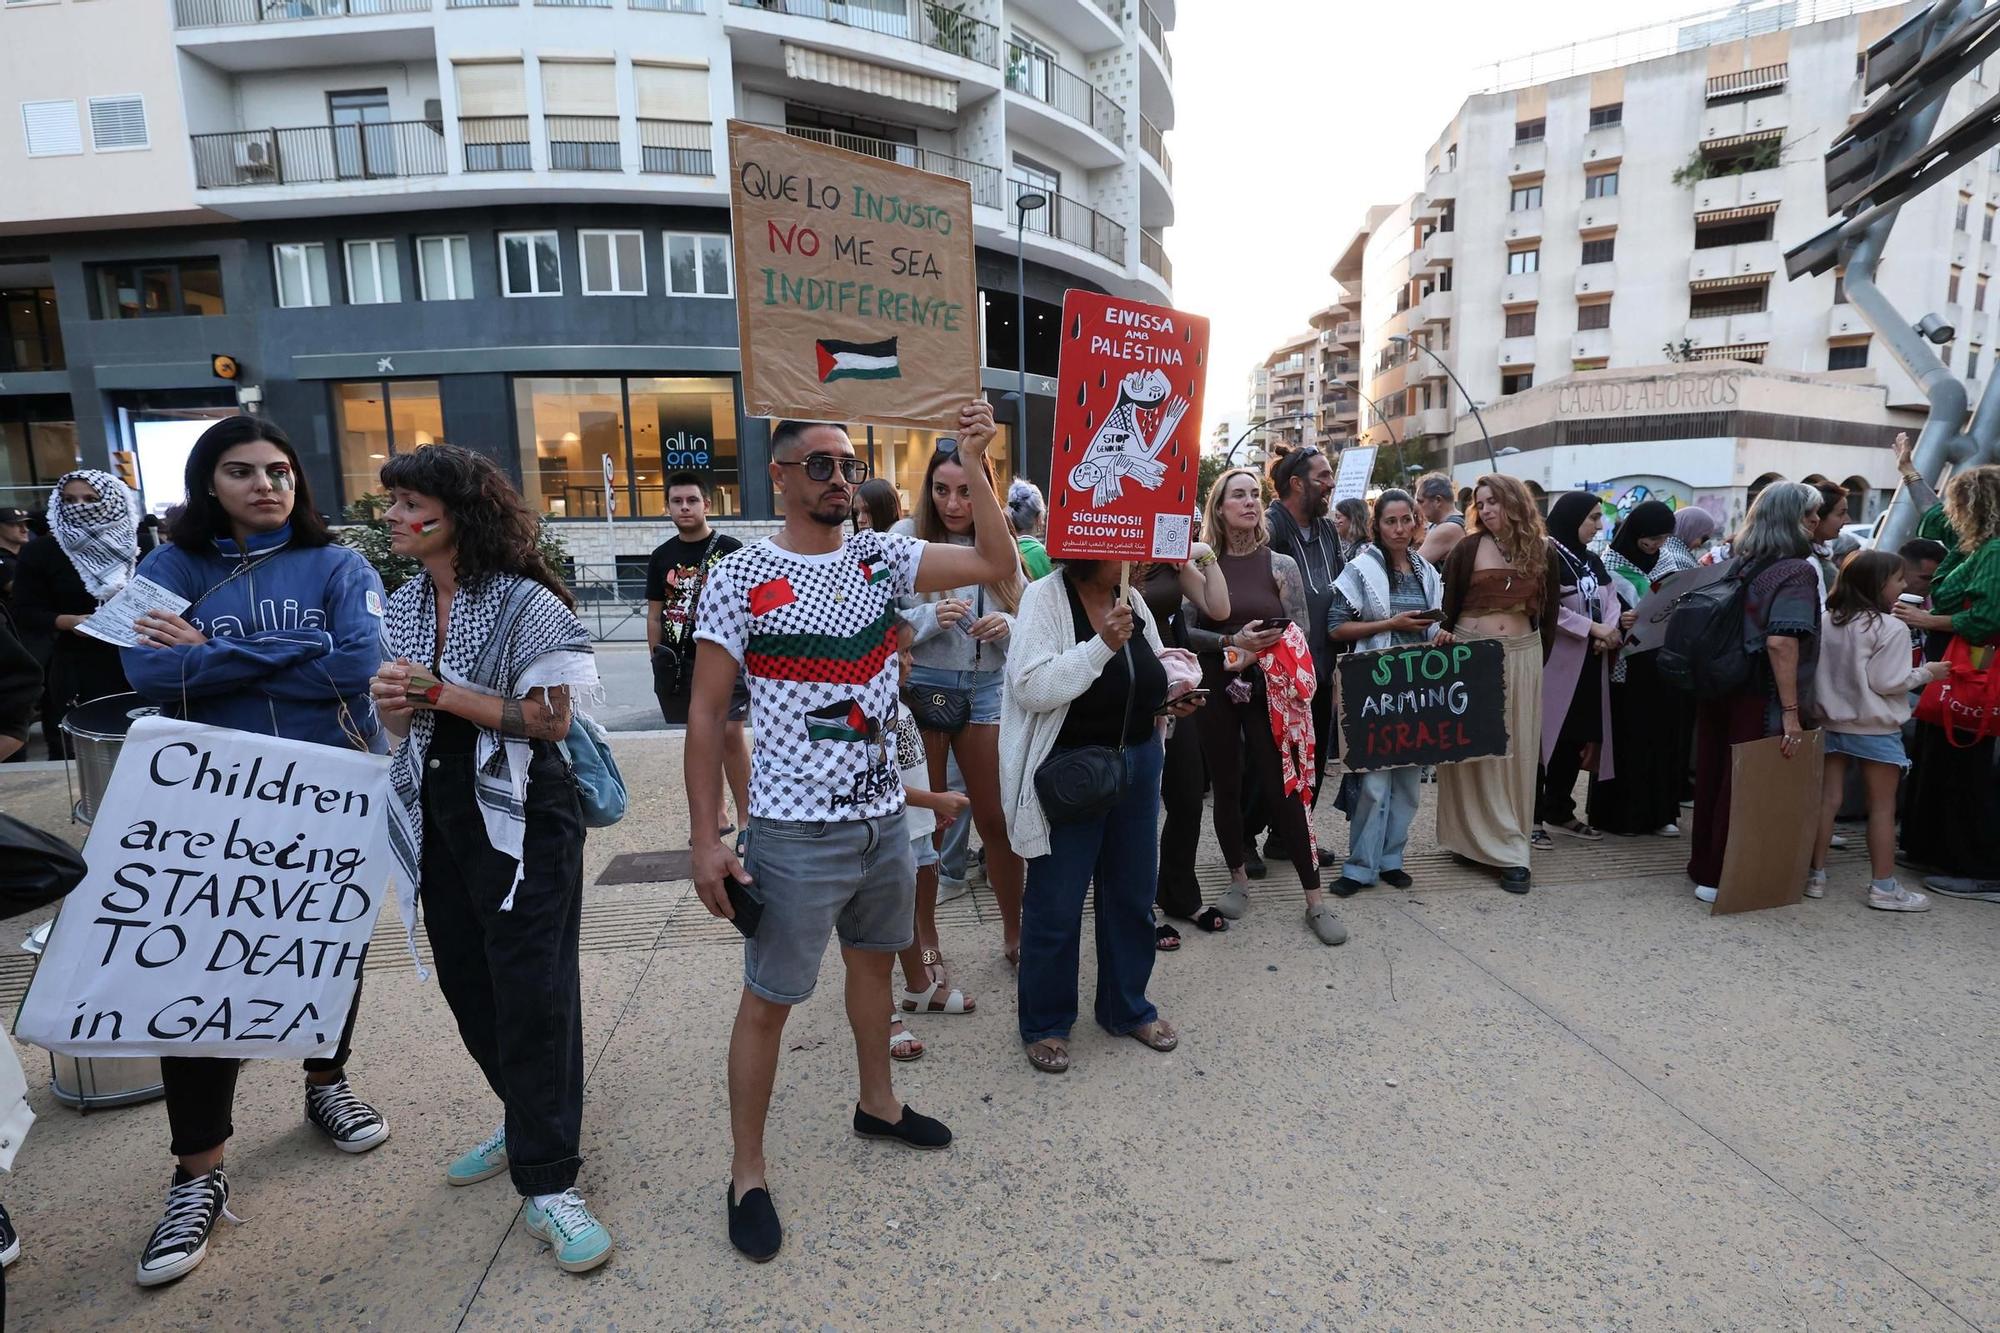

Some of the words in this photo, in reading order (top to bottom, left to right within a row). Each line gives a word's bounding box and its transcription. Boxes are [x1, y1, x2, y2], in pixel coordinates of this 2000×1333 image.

[741, 162, 799, 202] QUE
[807, 178, 841, 210] LO
[851, 186, 952, 235] INJUSTO
[768, 220, 820, 256] NO
[835, 235, 874, 265] ME
[891, 247, 942, 280] SEA
[761, 268, 964, 331] INDIFERENTE
[1105, 307, 1174, 334] EIVISSA
[1125, 330, 1149, 340] AMB
[1091, 336, 1183, 366] PALESTINA
[1558, 384, 1605, 414] CAJA
[1635, 374, 1741, 411] AHORROS
[666, 431, 685, 451] all
[689, 434, 708, 451] in
[1103, 433, 1130, 444] STOP
[667, 452, 709, 465] one
[1067, 525, 1118, 537] FOLLOW
[1120, 528, 1144, 539] US!!
[1072, 509, 1141, 525] SÍGUENOS!!
[1372, 645, 1472, 686] STOP
[150, 741, 369, 817] Children
[120, 820, 215, 859] are
[224, 817, 366, 885] being
[101, 862, 372, 924] STARVED
[93, 917, 187, 969] TO
[205, 929, 370, 980] DEATH
[70, 1002, 123, 1041] in
